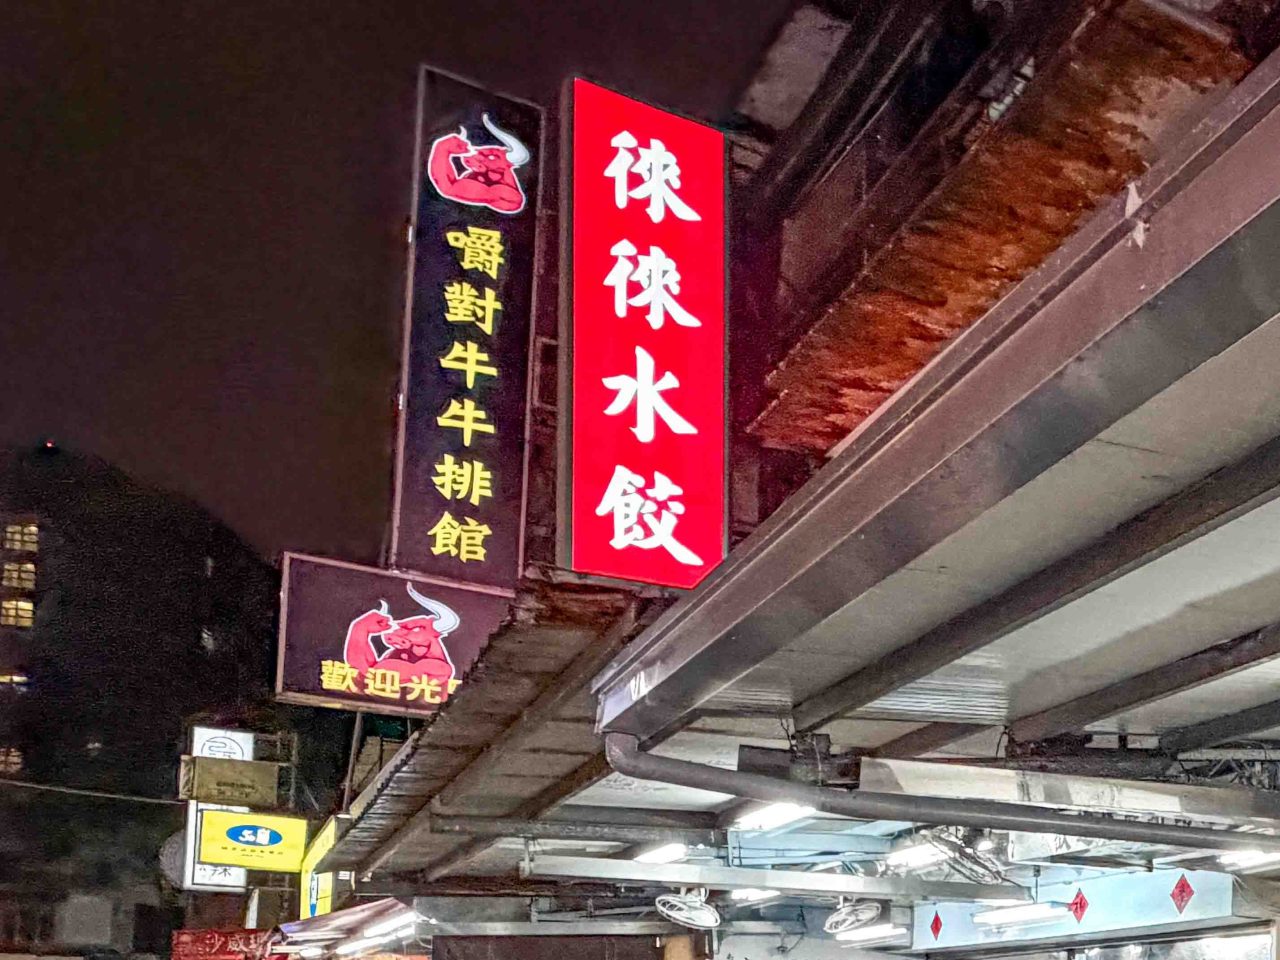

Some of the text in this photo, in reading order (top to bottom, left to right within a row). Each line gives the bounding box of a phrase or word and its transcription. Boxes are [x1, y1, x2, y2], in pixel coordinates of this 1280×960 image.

[427, 226, 505, 564] 嚼對牛牛排館
[596, 130, 703, 566] 徠徠水餃
